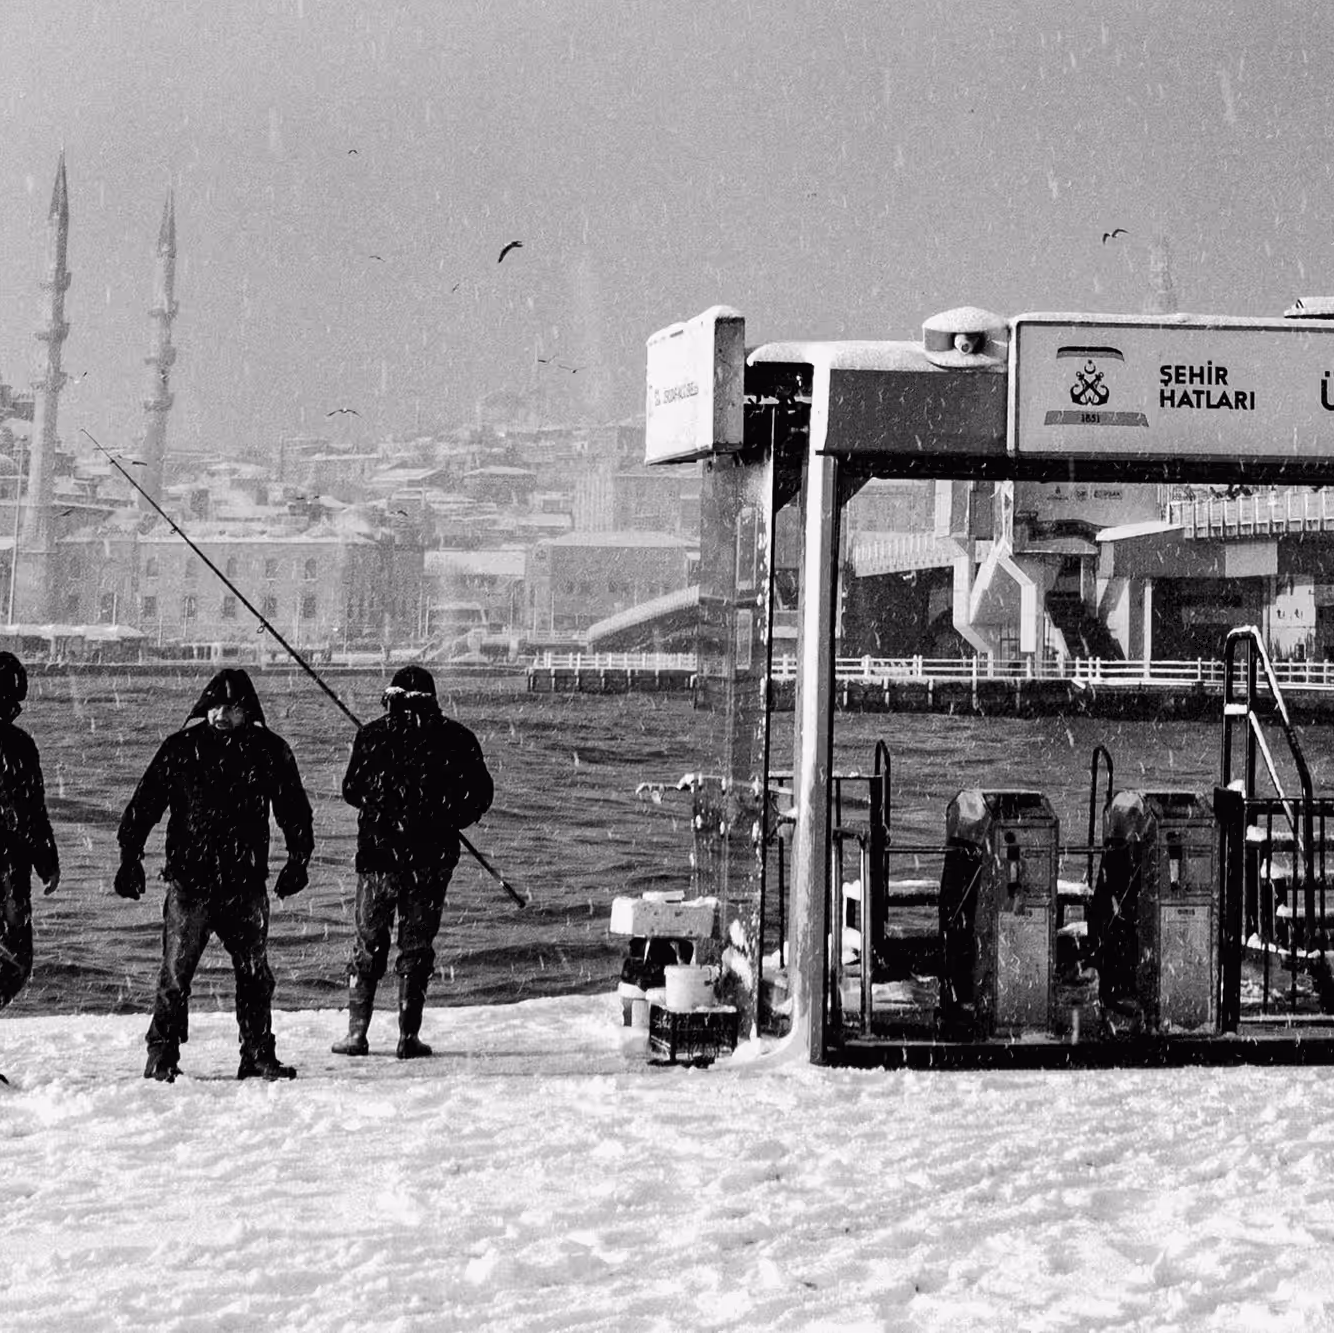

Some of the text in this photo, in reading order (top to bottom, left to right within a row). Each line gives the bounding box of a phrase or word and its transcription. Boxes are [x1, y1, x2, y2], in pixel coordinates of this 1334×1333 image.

[1159, 359, 1229, 387] ŞEHİR
[1159, 388, 1256, 411] HATLARI
[1081, 413, 1100, 424] 1851
